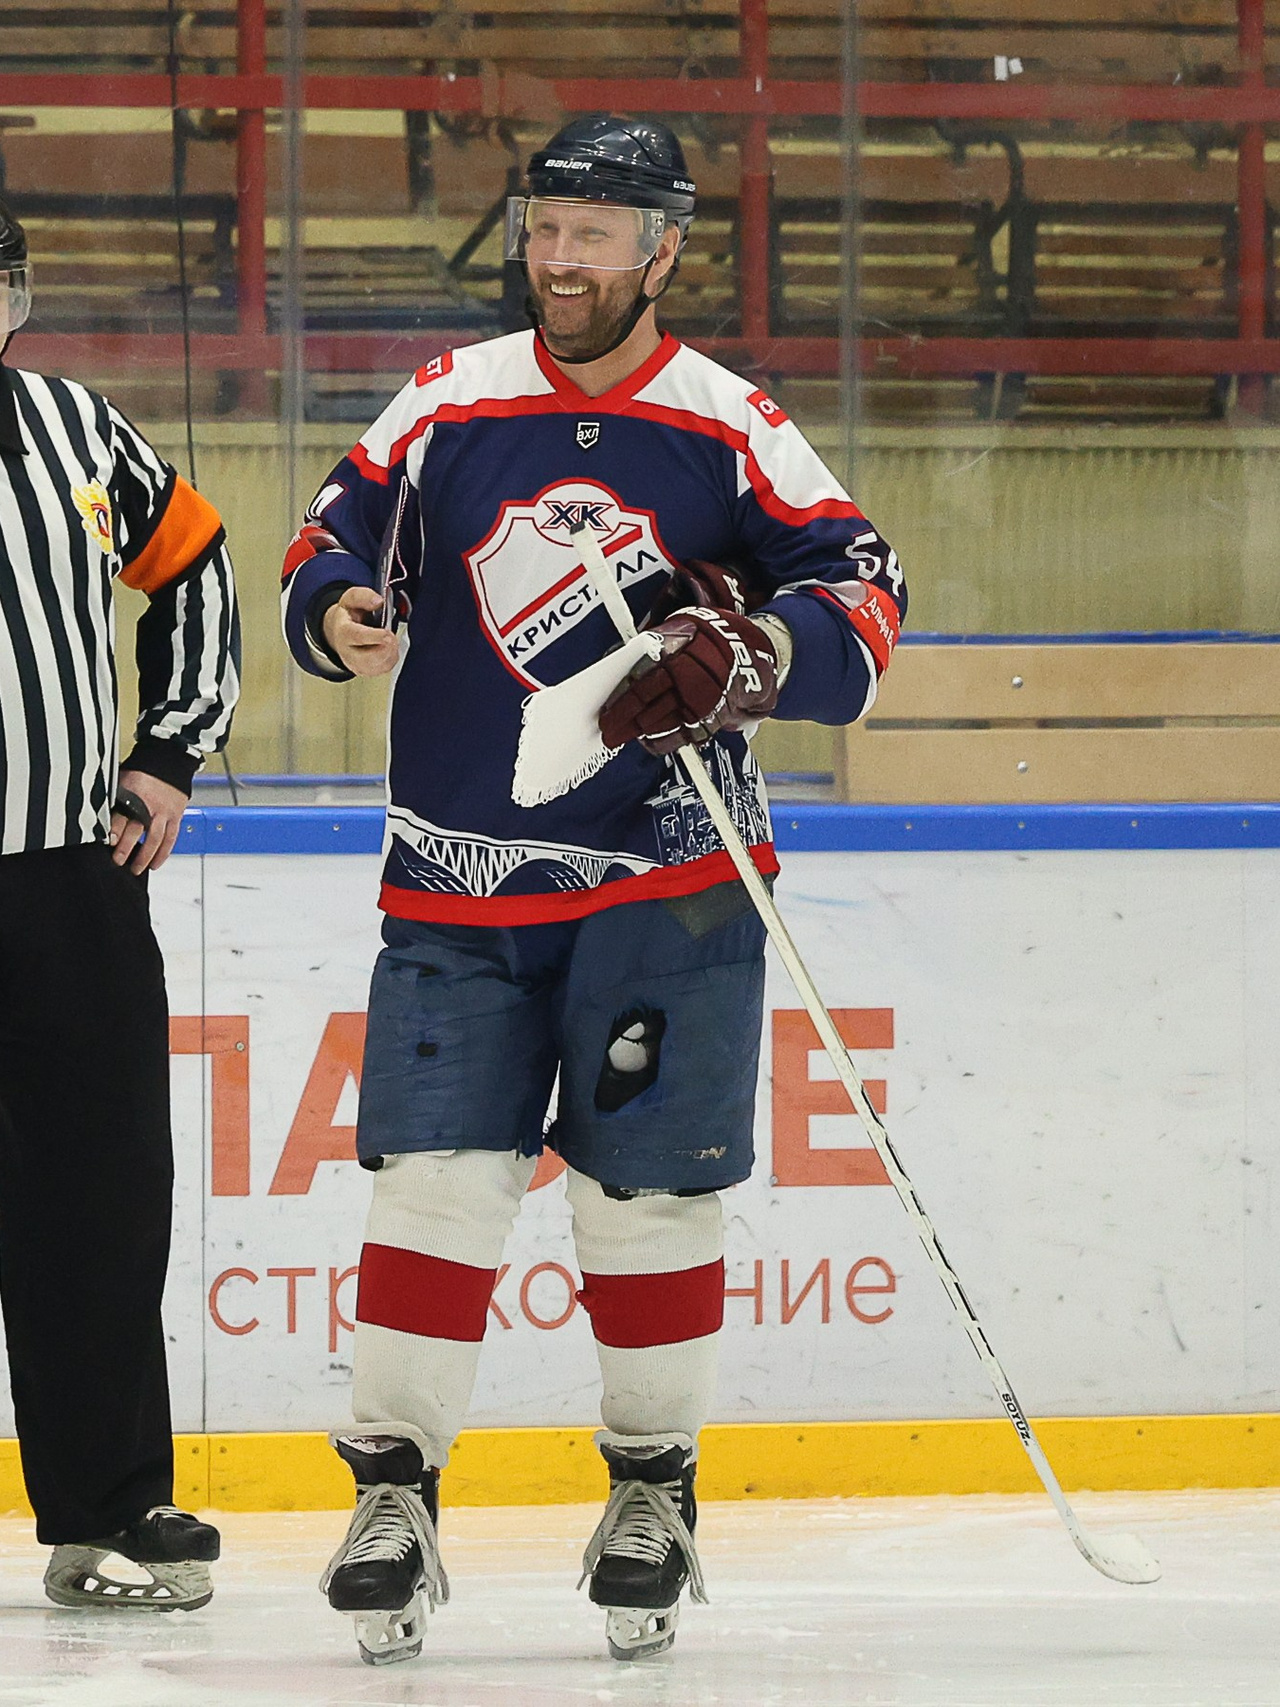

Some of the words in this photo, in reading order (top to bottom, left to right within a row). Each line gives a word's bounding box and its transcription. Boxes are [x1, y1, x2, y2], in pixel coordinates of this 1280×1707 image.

[544, 158, 593, 172] BAUER
[845, 531, 904, 597] 54
[506, 549, 659, 660] КРИСТЛЛ
[1002, 1393, 1031, 1440] SOYUZ
